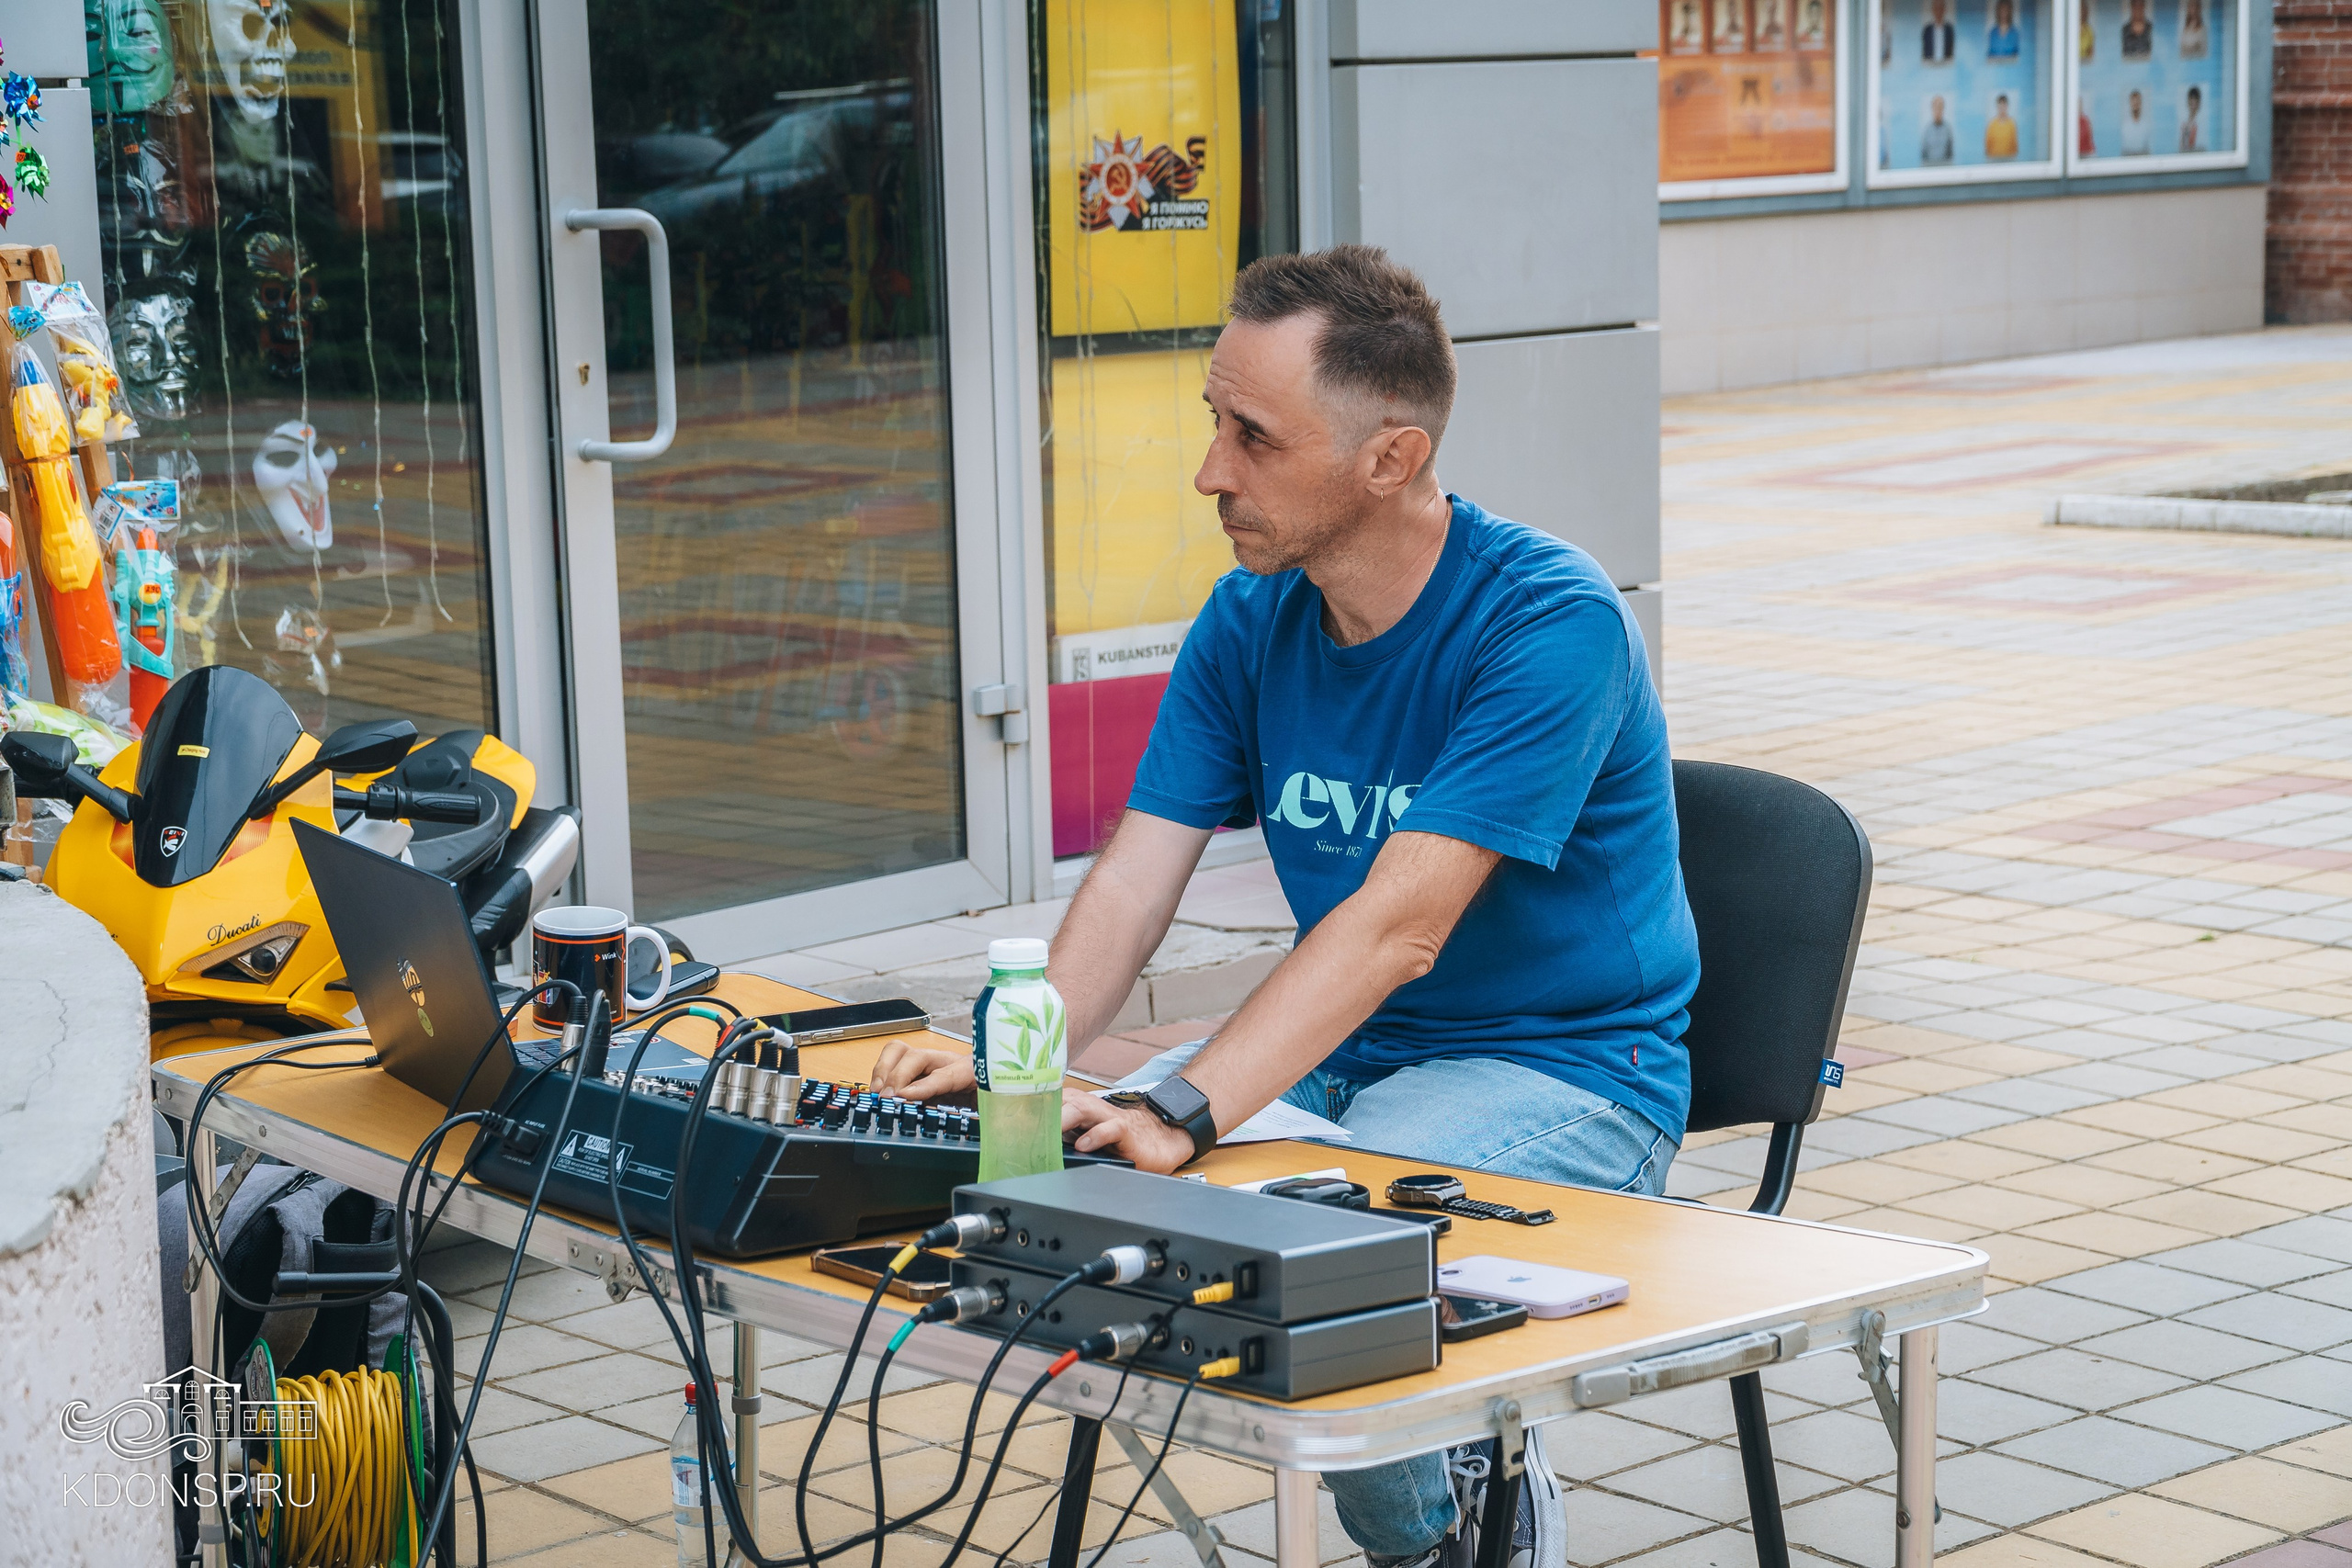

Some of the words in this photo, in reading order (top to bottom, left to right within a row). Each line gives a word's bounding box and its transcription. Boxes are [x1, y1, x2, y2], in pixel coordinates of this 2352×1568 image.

[1150, 202, 1159, 216] Я
[1142, 217, 1150, 230] Я
[1151, 215, 1207, 230] ГОРЖУСЬ
[1097, 643, 1180, 664] KUBANSTAR
[1314, 840, 1342, 854] Since
[207, 913, 262, 947] Ducati
[601, 952, 616, 961] Wink
[977, 1058, 987, 1084] tea
